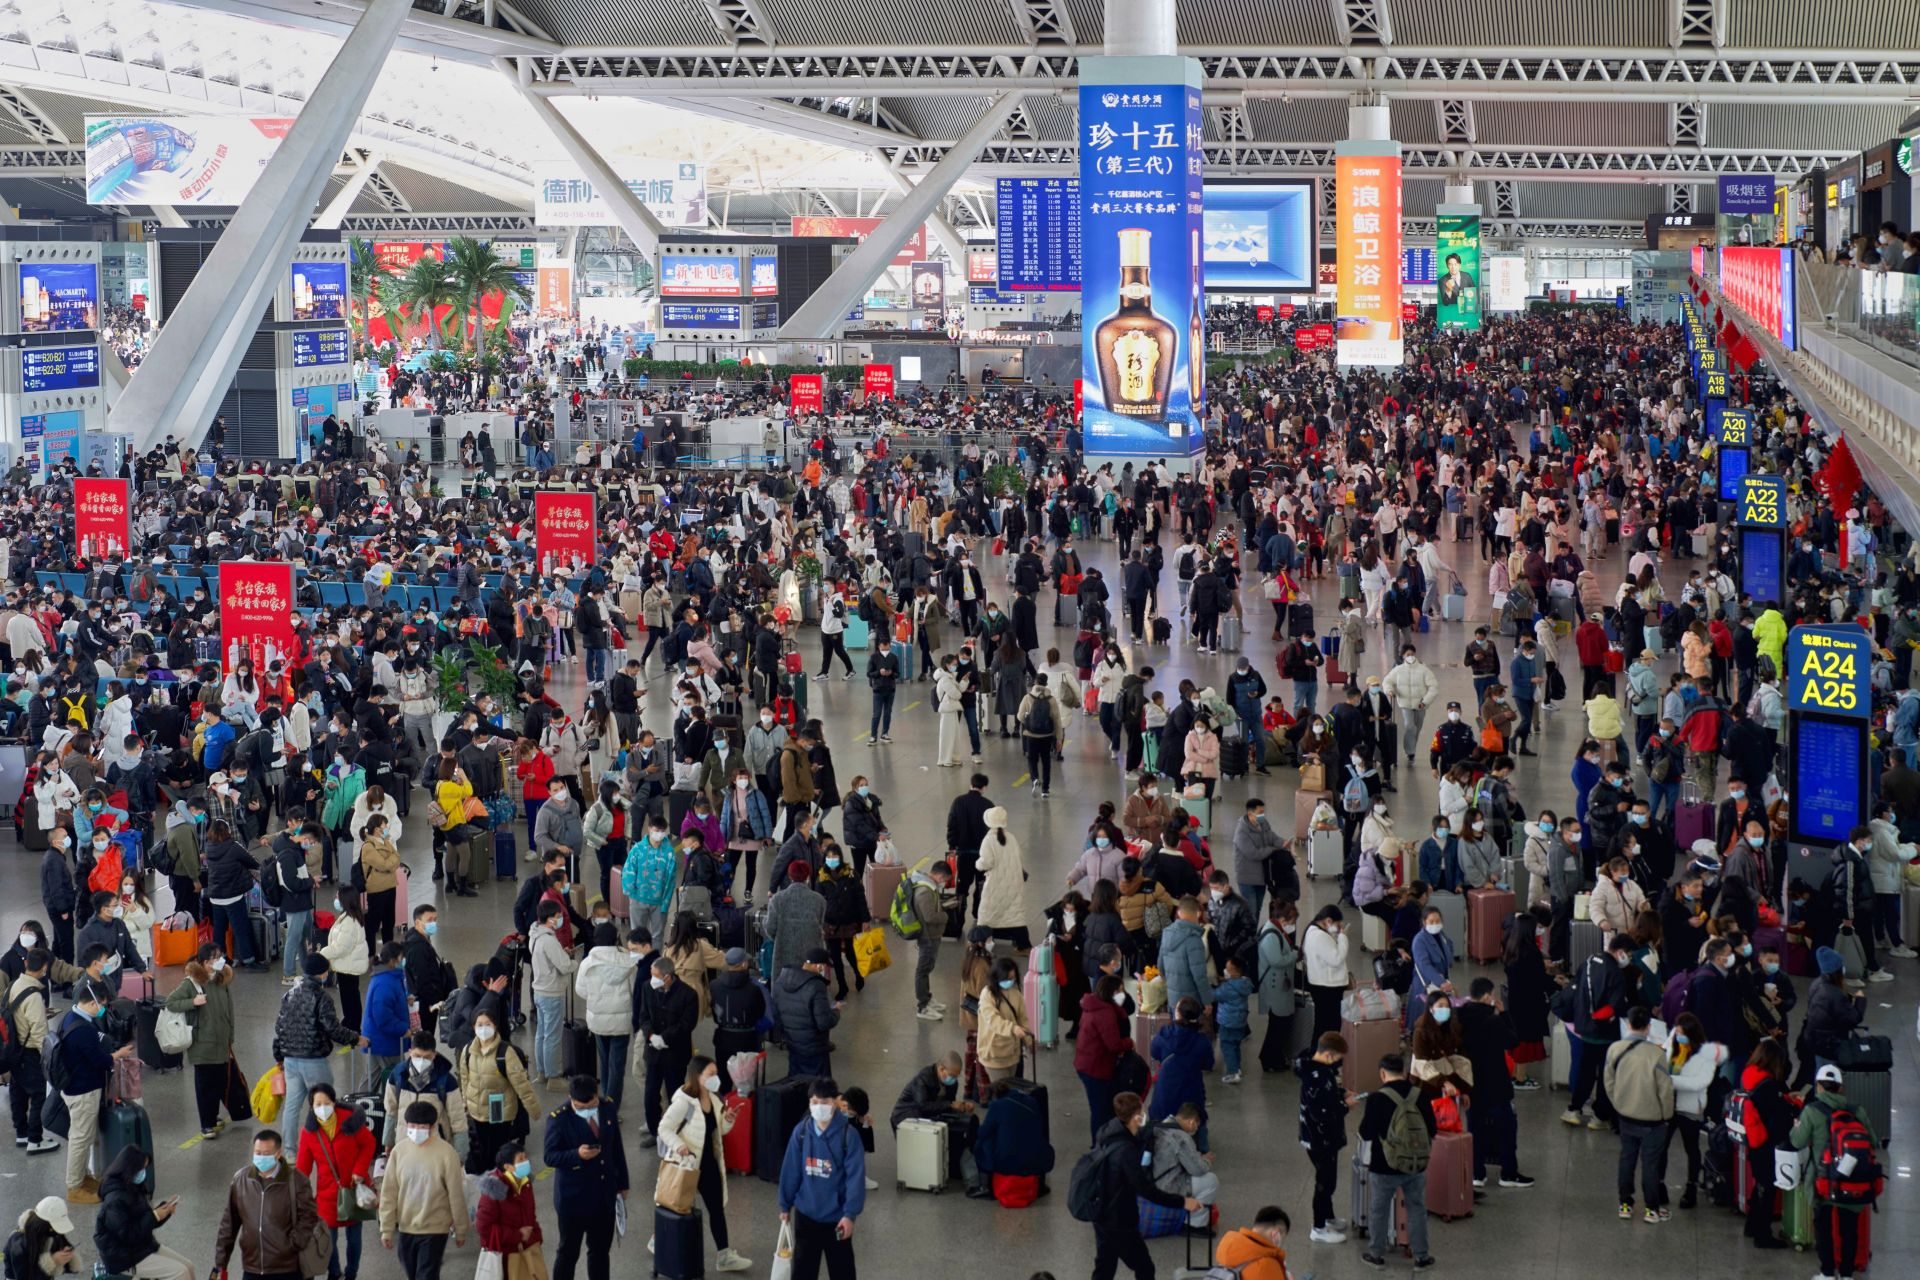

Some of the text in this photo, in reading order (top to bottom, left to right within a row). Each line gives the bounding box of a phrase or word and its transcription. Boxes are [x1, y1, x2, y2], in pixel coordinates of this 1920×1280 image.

[1088, 121, 1179, 151] 珍十五
[1096, 156, 1173, 175] （第三代）
[543, 179, 673, 204] 德利岩板
[1726, 184, 1767, 197] 吸烟室
[1665, 216, 1692, 225] 肯德基
[1352, 186, 1381, 286] 浪鲸卫浴
[1708, 376, 1725, 385] A18
[1708, 386, 1725, 395] A19
[1723, 418, 1746, 431] A20
[1723, 432, 1745, 442] A21
[1745, 488, 1778, 505] A22
[1745, 506, 1778, 523] A23
[1802, 634, 1831, 647] 检票口
[1832, 640, 1850, 648] Check
[1802, 650, 1856, 680] A24
[1801, 679, 1857, 709] A25
